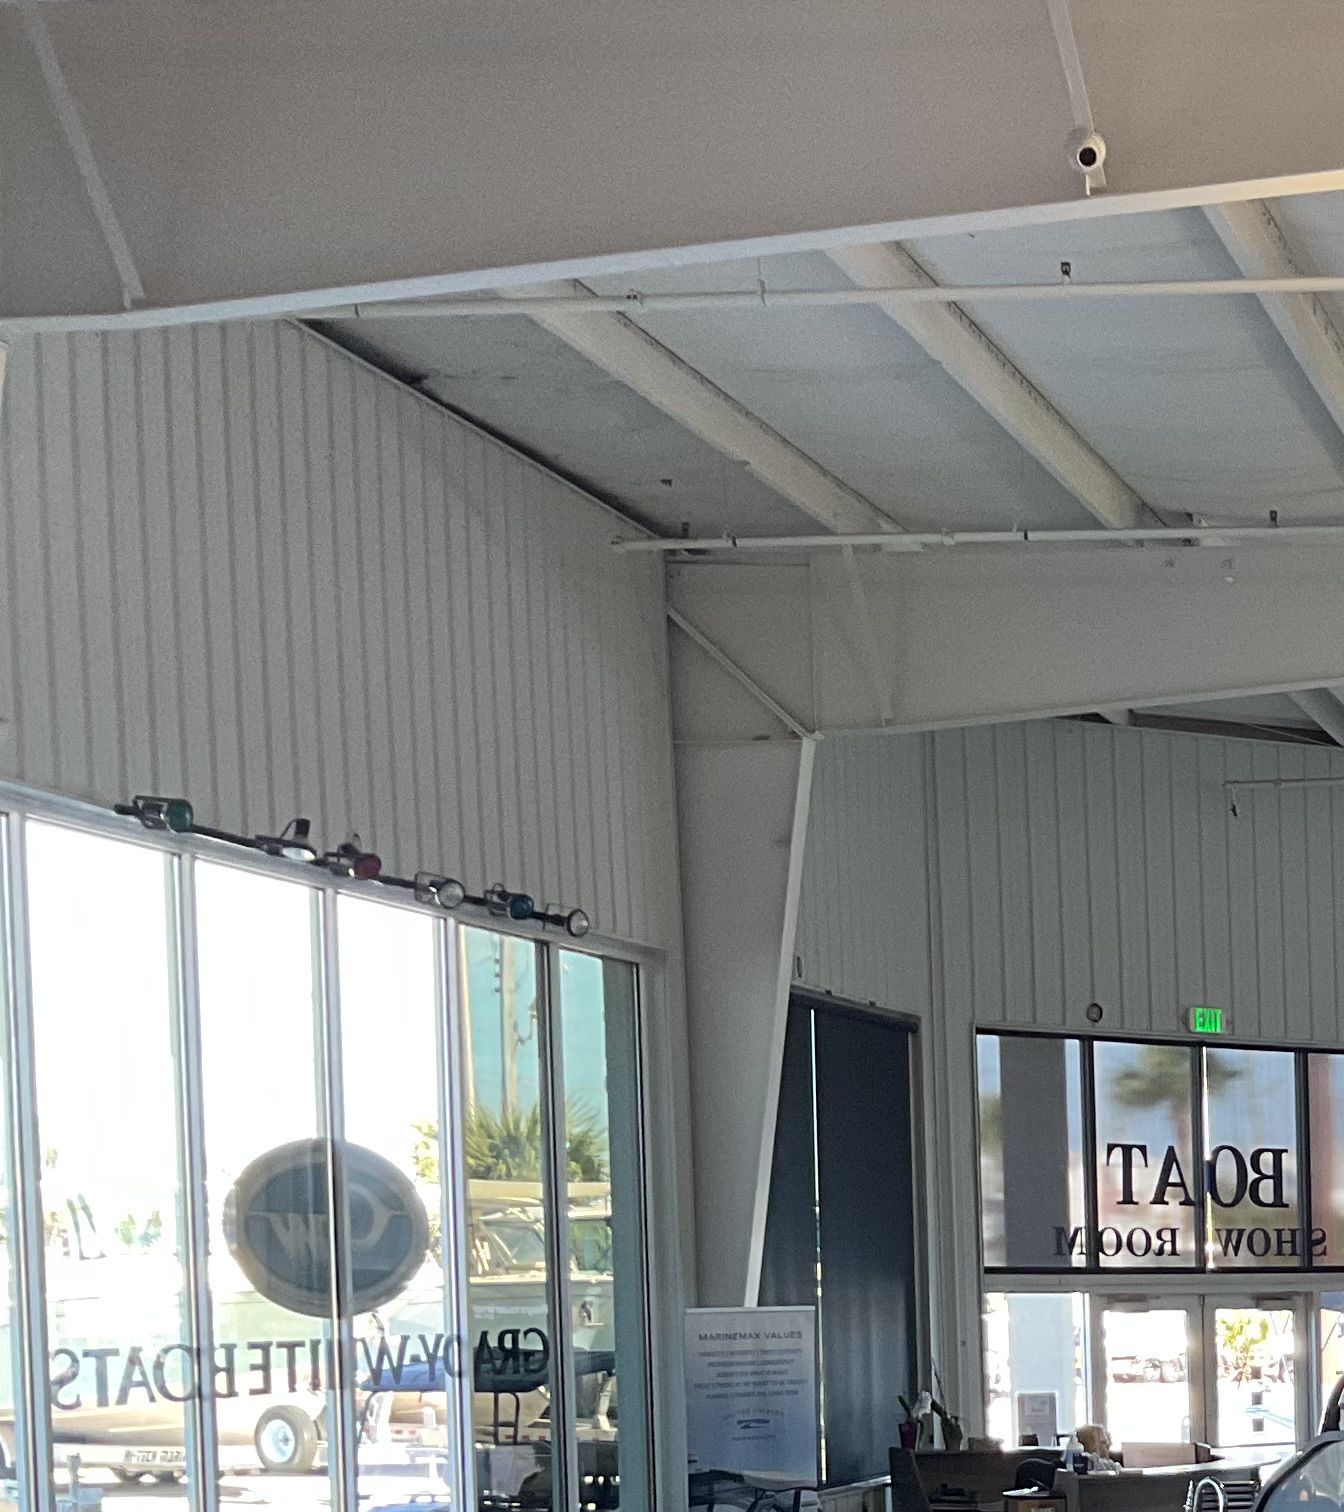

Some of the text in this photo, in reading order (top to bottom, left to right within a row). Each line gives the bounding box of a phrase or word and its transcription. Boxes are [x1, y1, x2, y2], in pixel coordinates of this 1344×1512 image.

[1195, 1007, 1222, 1033] EXIT
[698, 1330, 803, 1341] MARINEMAX VALUES
